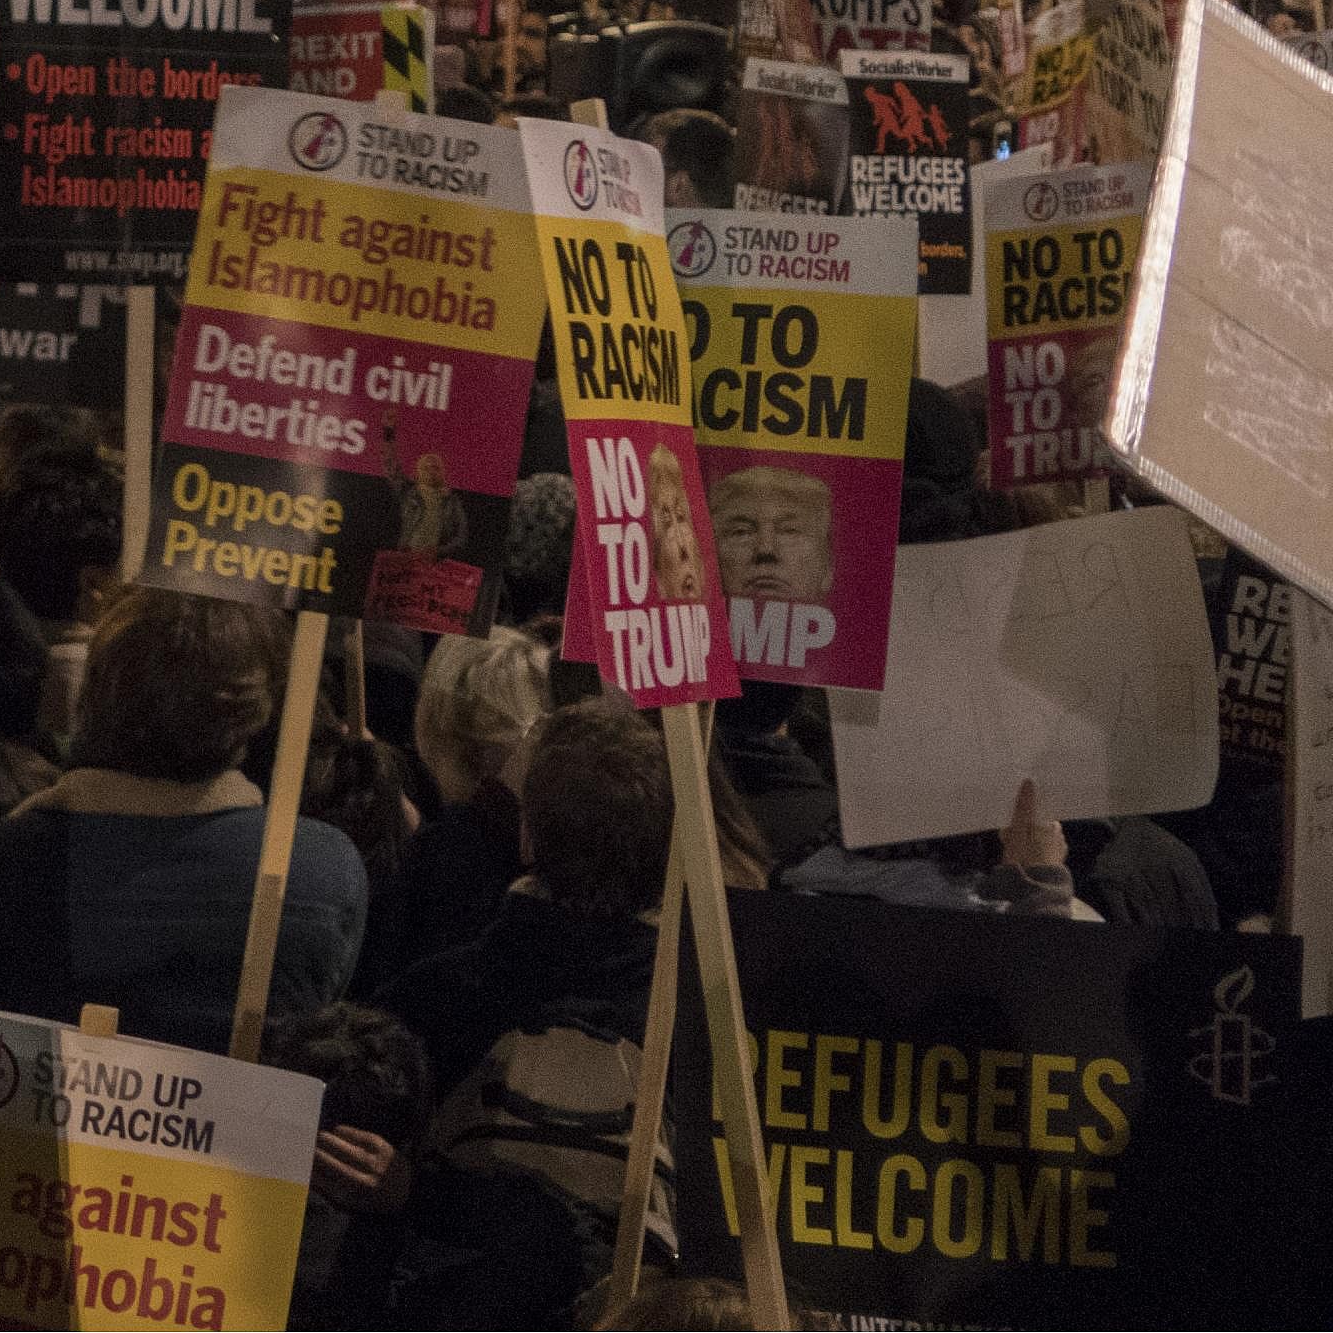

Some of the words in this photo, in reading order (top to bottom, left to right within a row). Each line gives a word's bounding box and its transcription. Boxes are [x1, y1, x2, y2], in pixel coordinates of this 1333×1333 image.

[25, 52, 96, 103] Open
[107, 58, 157, 99] the
[23, 112, 95, 164] Fight
[104, 117, 192, 158] racism
[359, 121, 434, 160] STAND
[441, 135, 482, 166] UP
[850, 155, 966, 185] REFUGEES
[21, 166, 201, 216] Islamophobia
[355, 150, 393, 181] TO
[394, 157, 491, 200] RACISM
[851, 184, 964, 213] WELCOME
[214, 183, 326, 248] Fight
[338, 212, 499, 272] against
[724, 225, 800, 253] STAND
[806, 231, 840, 256] UP
[1001, 234, 1063, 283] NO
[1072, 227, 1124, 276] TO
[206, 239, 499, 333] Islamophobia
[553, 236, 612, 318] NO
[615, 241, 659, 322] TO
[723, 253, 753, 277] TO
[758, 258, 851, 283] RACISM
[568, 321, 681, 407] RACISM
[732, 301, 819, 369] TO
[1003, 341, 1066, 390] NO
[193, 323, 358, 400] Defend
[365, 354, 455, 414] civil
[183, 381, 369, 457] liberties
[694, 368, 869, 442] CISM
[1004, 388, 1063, 434] TO
[170, 462, 344, 537] Oppose
[585, 435, 648, 521] NO
[162, 519, 339, 596] Prevent
[596, 522, 652, 606] TO
[32, 1051, 146, 1104] STAND
[152, 1074, 203, 1111] UP
[32, 1091, 74, 1129] TO
[79, 1104, 215, 1156] RACISM
[11, 1168, 228, 1254] against
[711, 1136, 1117, 1268] WELCOME
